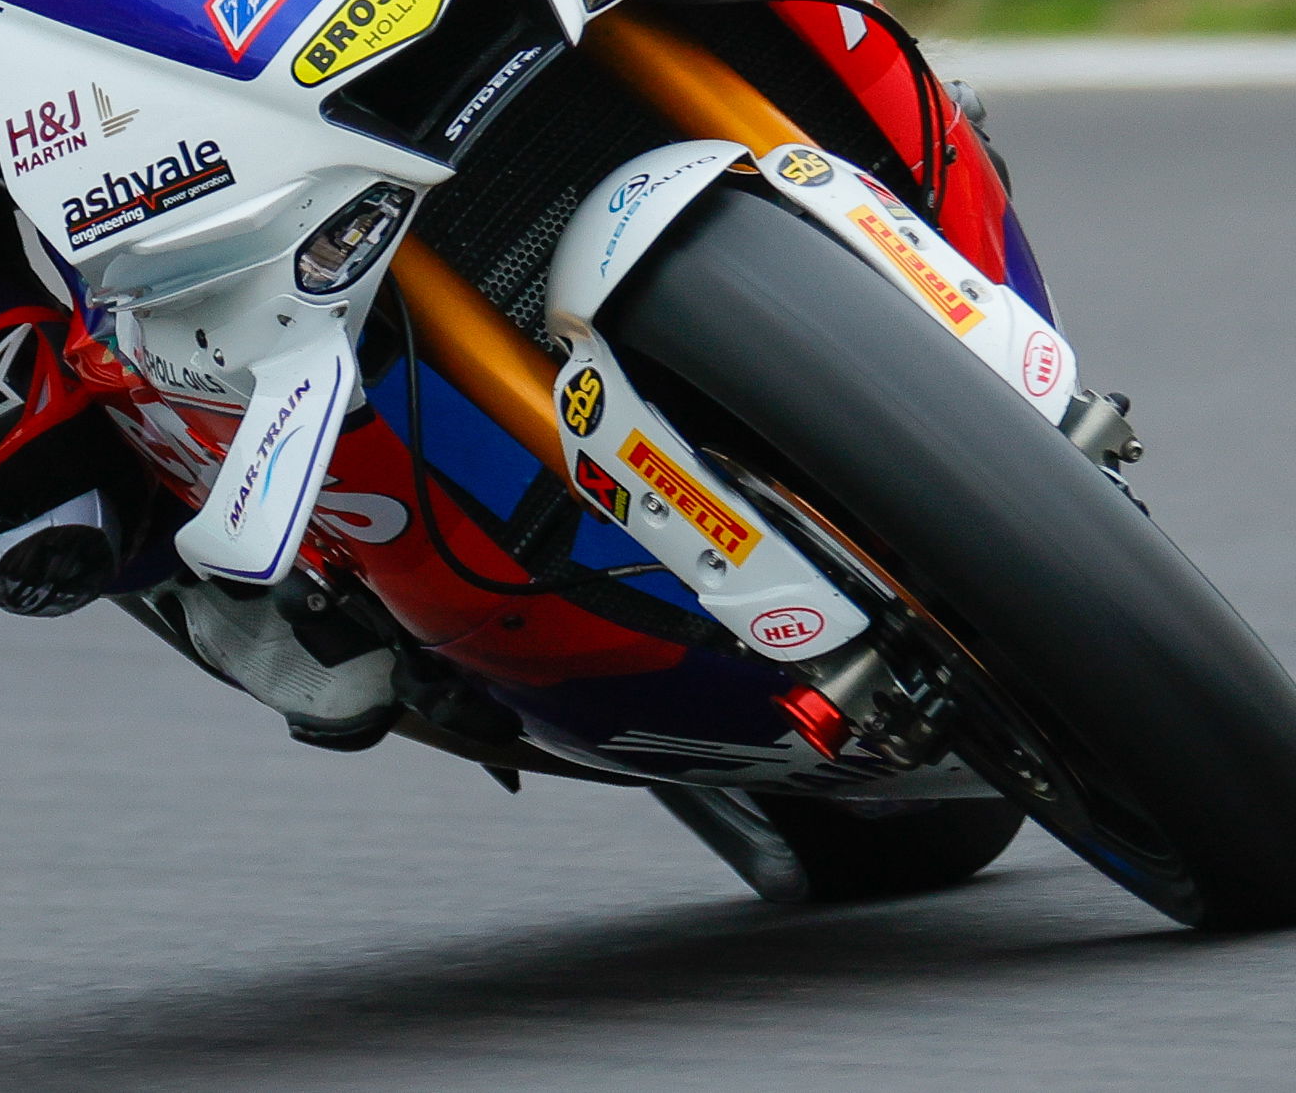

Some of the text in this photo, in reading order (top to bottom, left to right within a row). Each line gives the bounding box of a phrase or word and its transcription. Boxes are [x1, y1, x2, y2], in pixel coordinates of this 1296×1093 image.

[5, 89, 81, 158] H&J
[444, 50, 524, 142] SPIDER
[13, 131, 88, 177] MARTIN
[61, 138, 225, 228] ashvale
[71, 173, 230, 246] engineering power generation
[858, 214, 974, 325] PIRELLI
[1037, 343, 1057, 384] HEL
[229, 378, 313, 530] MAR-TRAIN
[627, 440, 749, 554] PIRELLI
[763, 621, 814, 641] HEL
